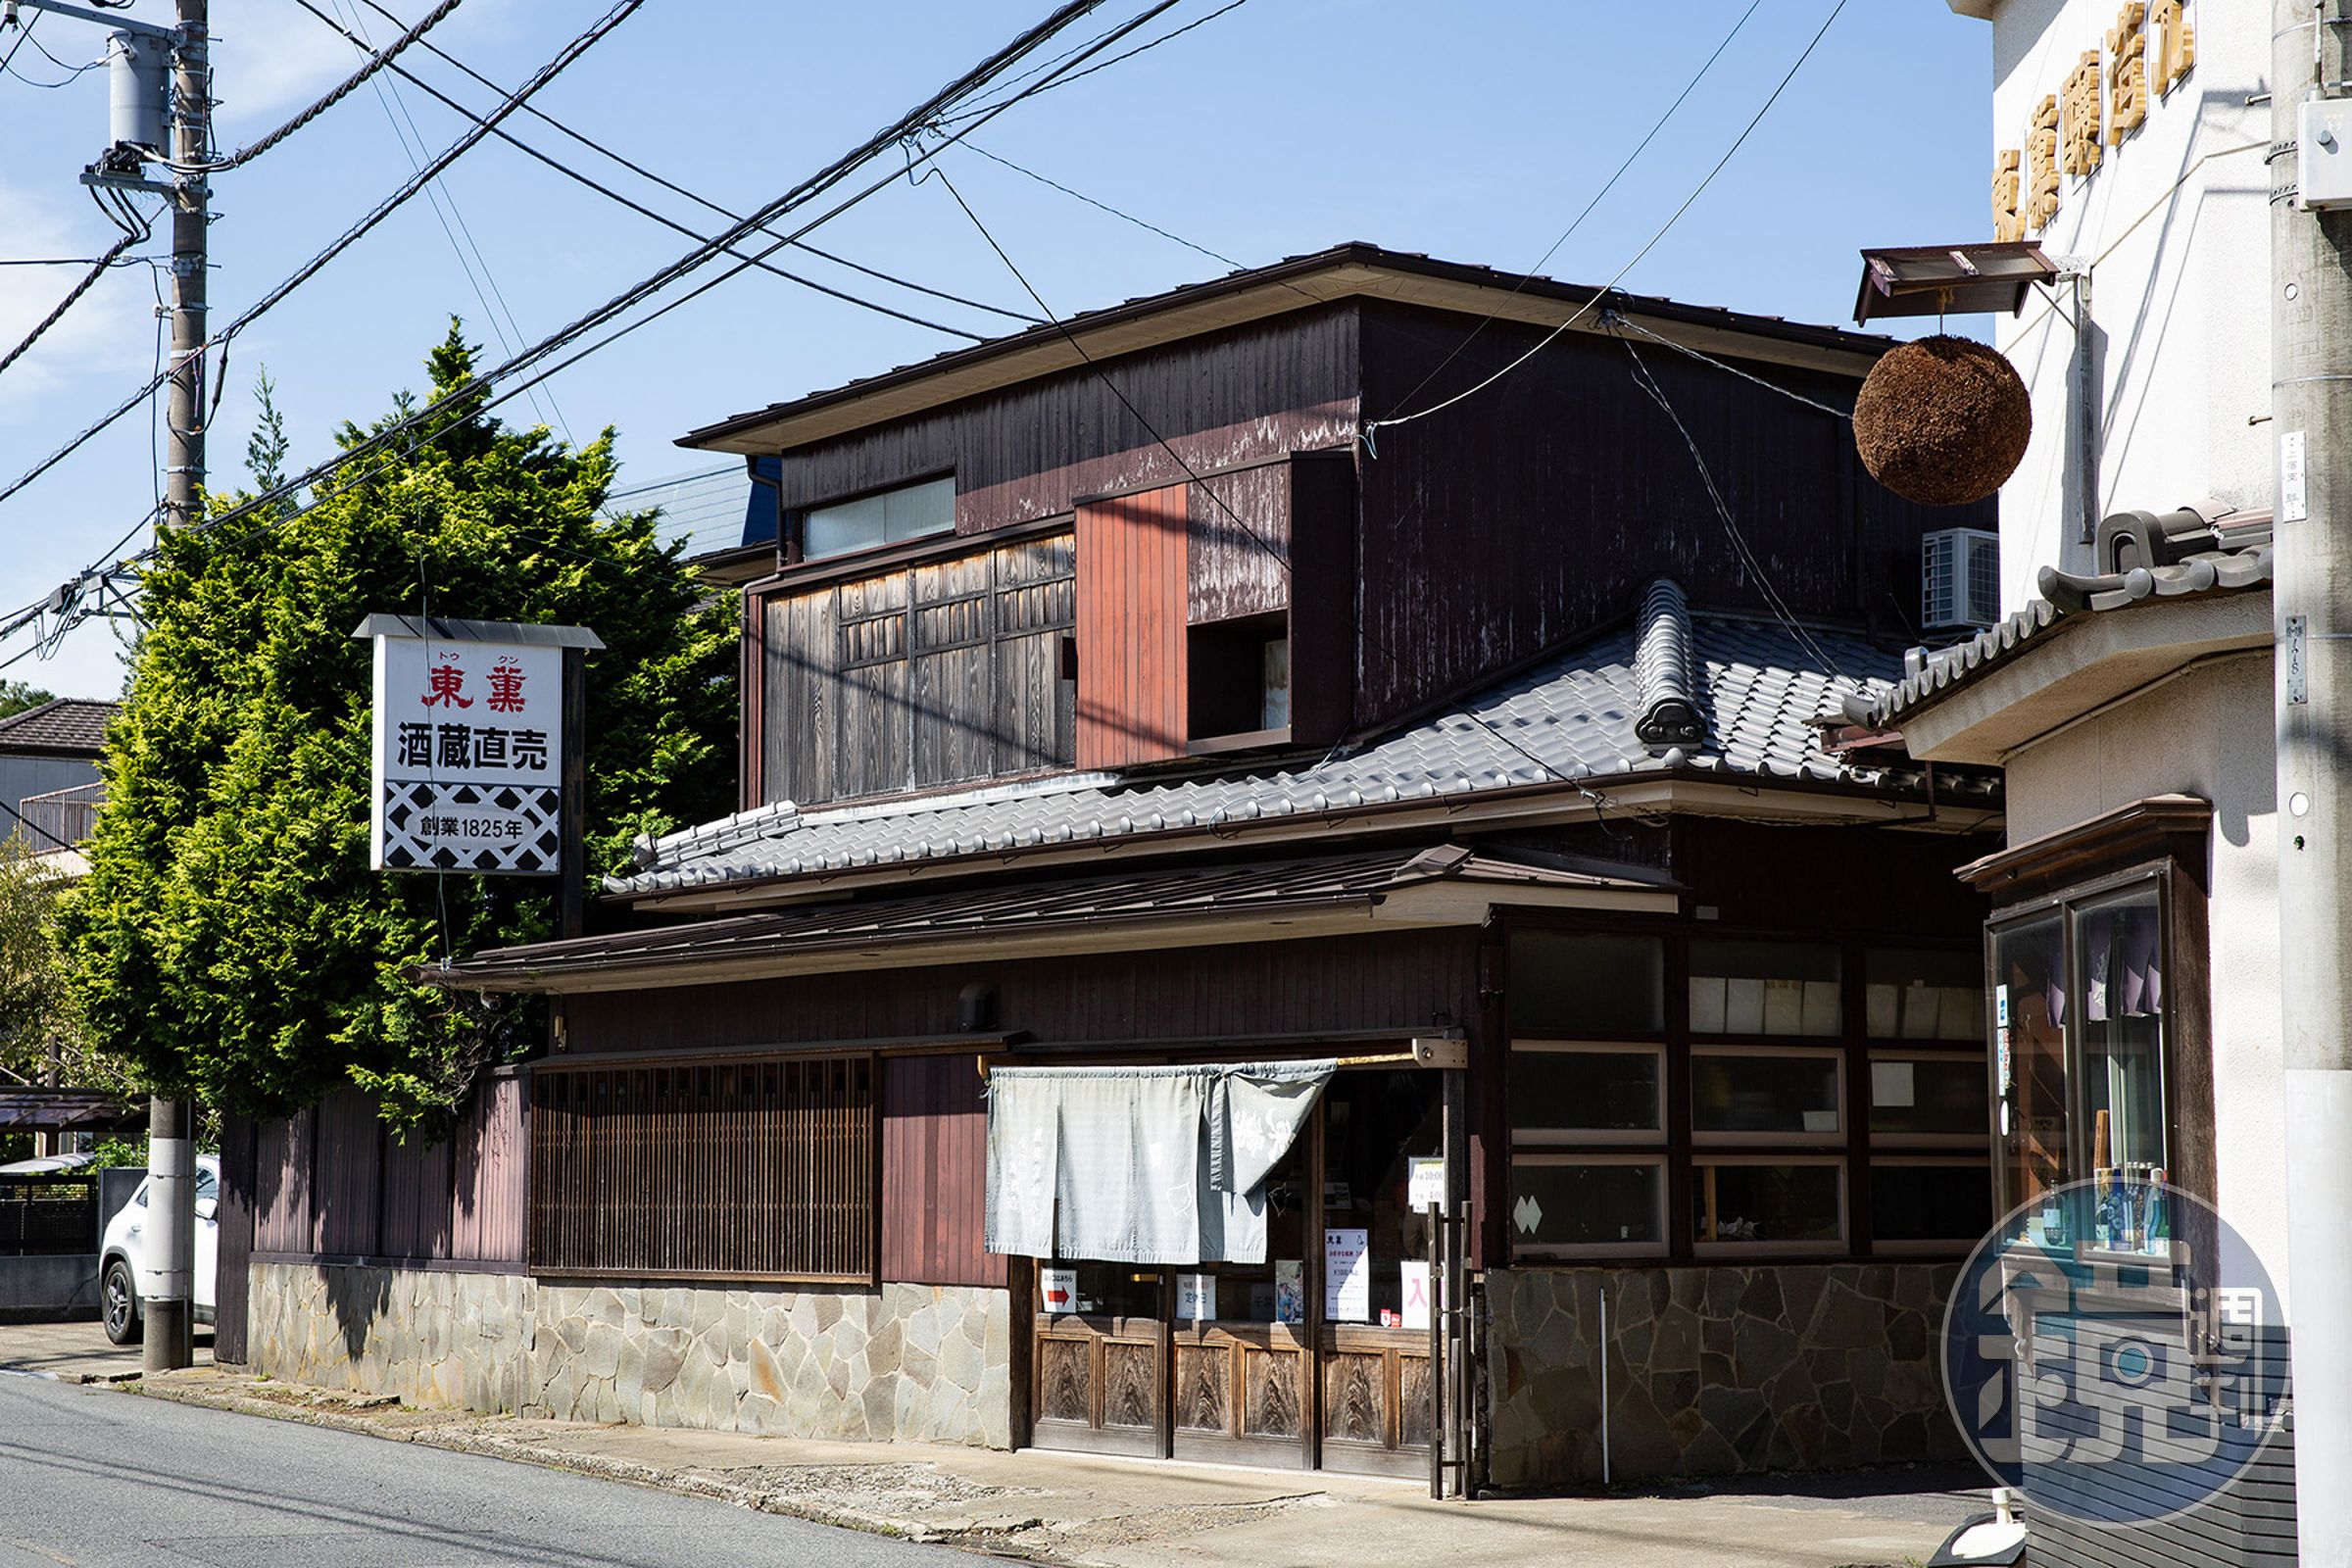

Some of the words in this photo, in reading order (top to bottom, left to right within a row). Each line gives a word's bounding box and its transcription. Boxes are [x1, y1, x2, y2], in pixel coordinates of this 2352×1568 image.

[439, 652, 461, 662] トウ
[498, 655, 519, 664] クン
[421, 664, 528, 713] 東薫
[397, 720, 548, 771] 酒蔵直売
[420, 815, 524, 840] 創業1825年
